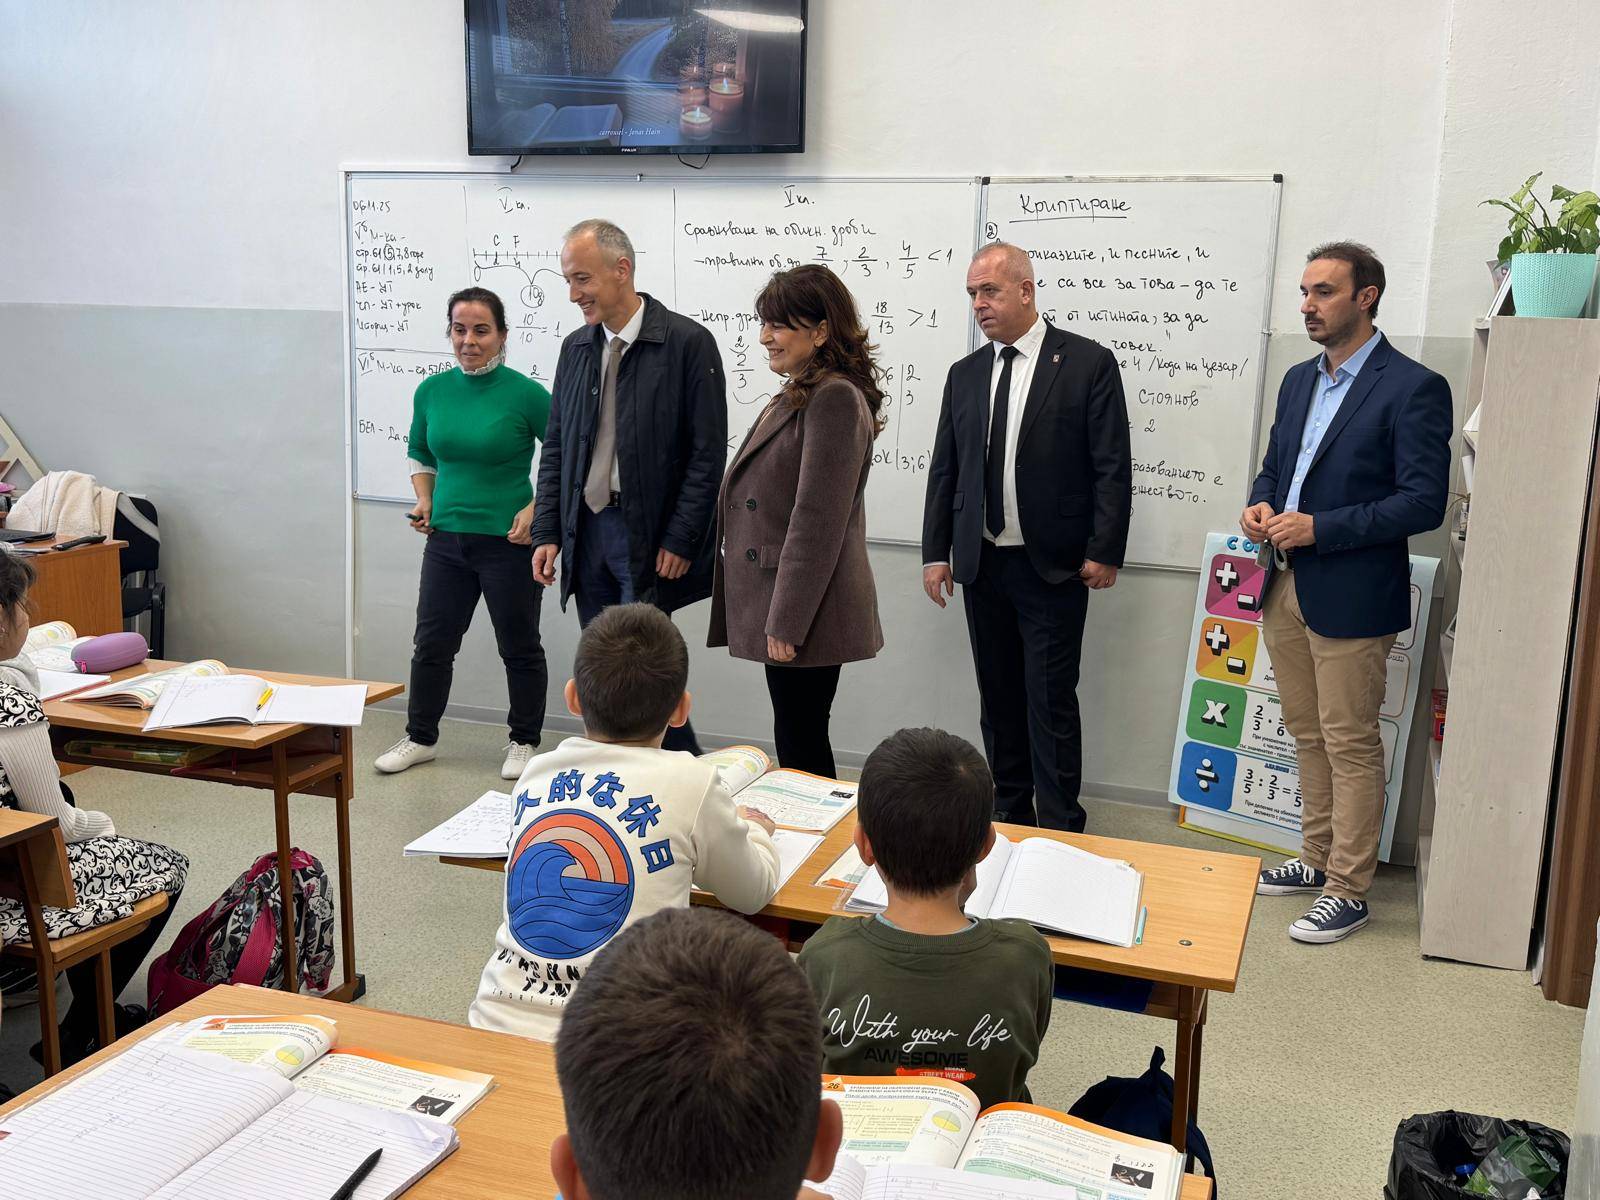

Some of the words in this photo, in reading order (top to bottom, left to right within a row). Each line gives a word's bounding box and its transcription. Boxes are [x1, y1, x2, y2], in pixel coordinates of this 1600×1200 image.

[1020, 193, 1132, 223] Криптиране
[765, 224, 779, 236] на
[1057, 278, 1077, 289] са
[1083, 277, 1107, 290] все
[1194, 279, 1216, 301] да
[1163, 311, 1181, 323] за
[1185, 312, 1209, 332] да
[1213, 475, 1224, 486] е
[1256, 705, 1264, 716] 2
[1253, 719, 1261, 731] 3
[1276, 726, 1285, 737] 6
[1246, 768, 1254, 780] 3
[1270, 774, 1278, 786] 2
[1243, 783, 1252, 794] 5
[1267, 789, 1276, 800] 3
[827, 994, 900, 1048] With
[902, 1026, 959, 1053] your
[967, 1013, 1012, 1050] life
[863, 1047, 969, 1066] AWESOME
